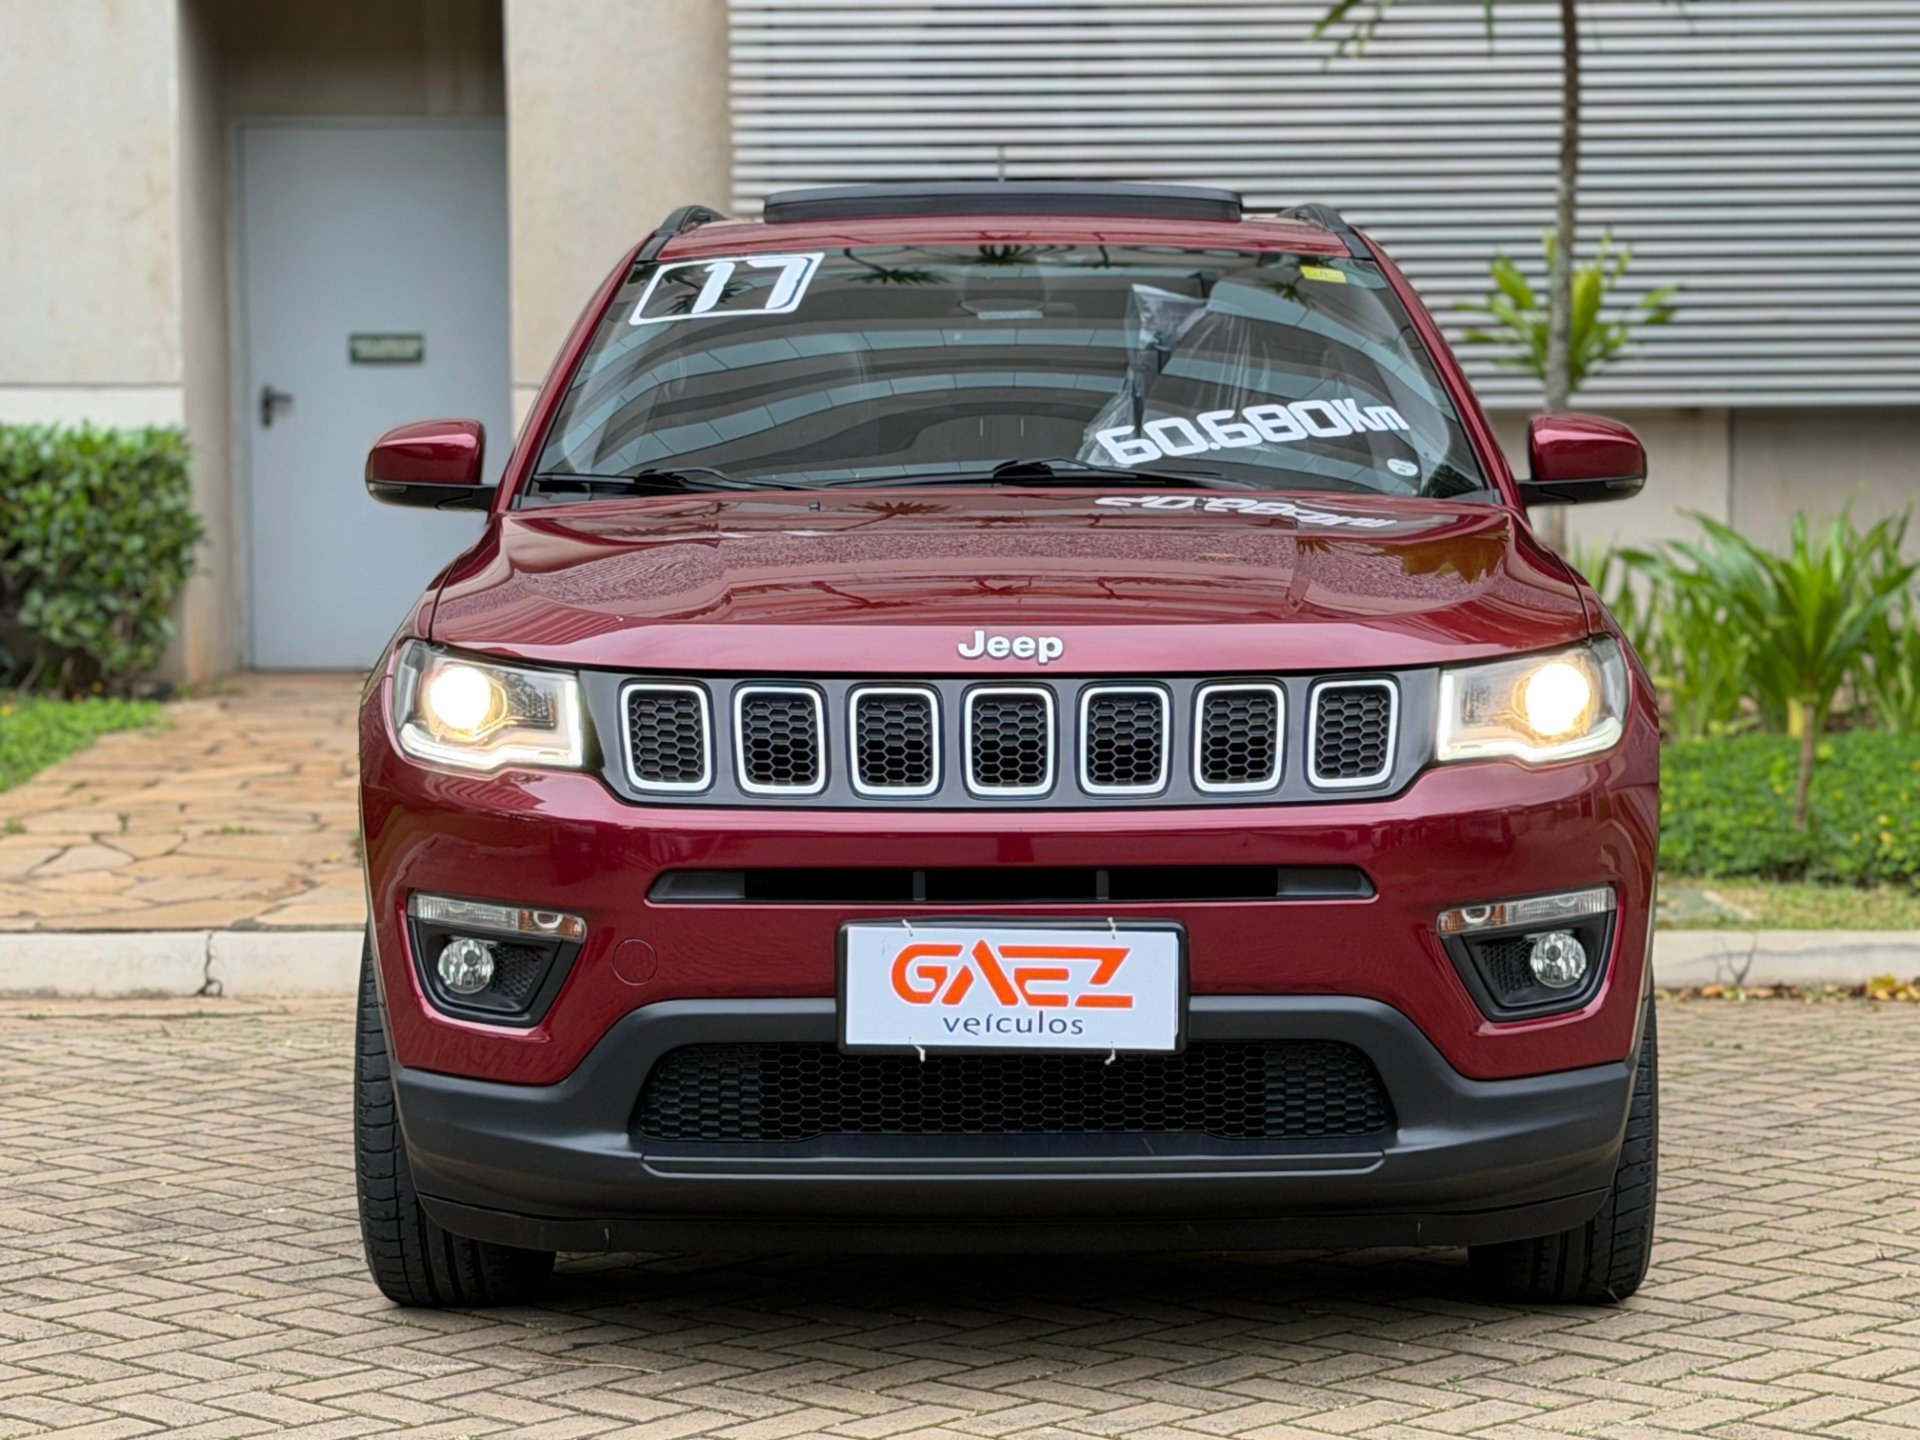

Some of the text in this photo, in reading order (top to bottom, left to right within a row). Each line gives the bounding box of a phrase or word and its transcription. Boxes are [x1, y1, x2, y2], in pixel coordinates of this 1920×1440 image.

[690, 257, 811, 315] 17
[1095, 398, 1410, 465] 60.680Km
[957, 630, 1064, 665] Jeep
[891, 939, 1134, 1009] GAEZ
[942, 1010, 1085, 1036] veículos
